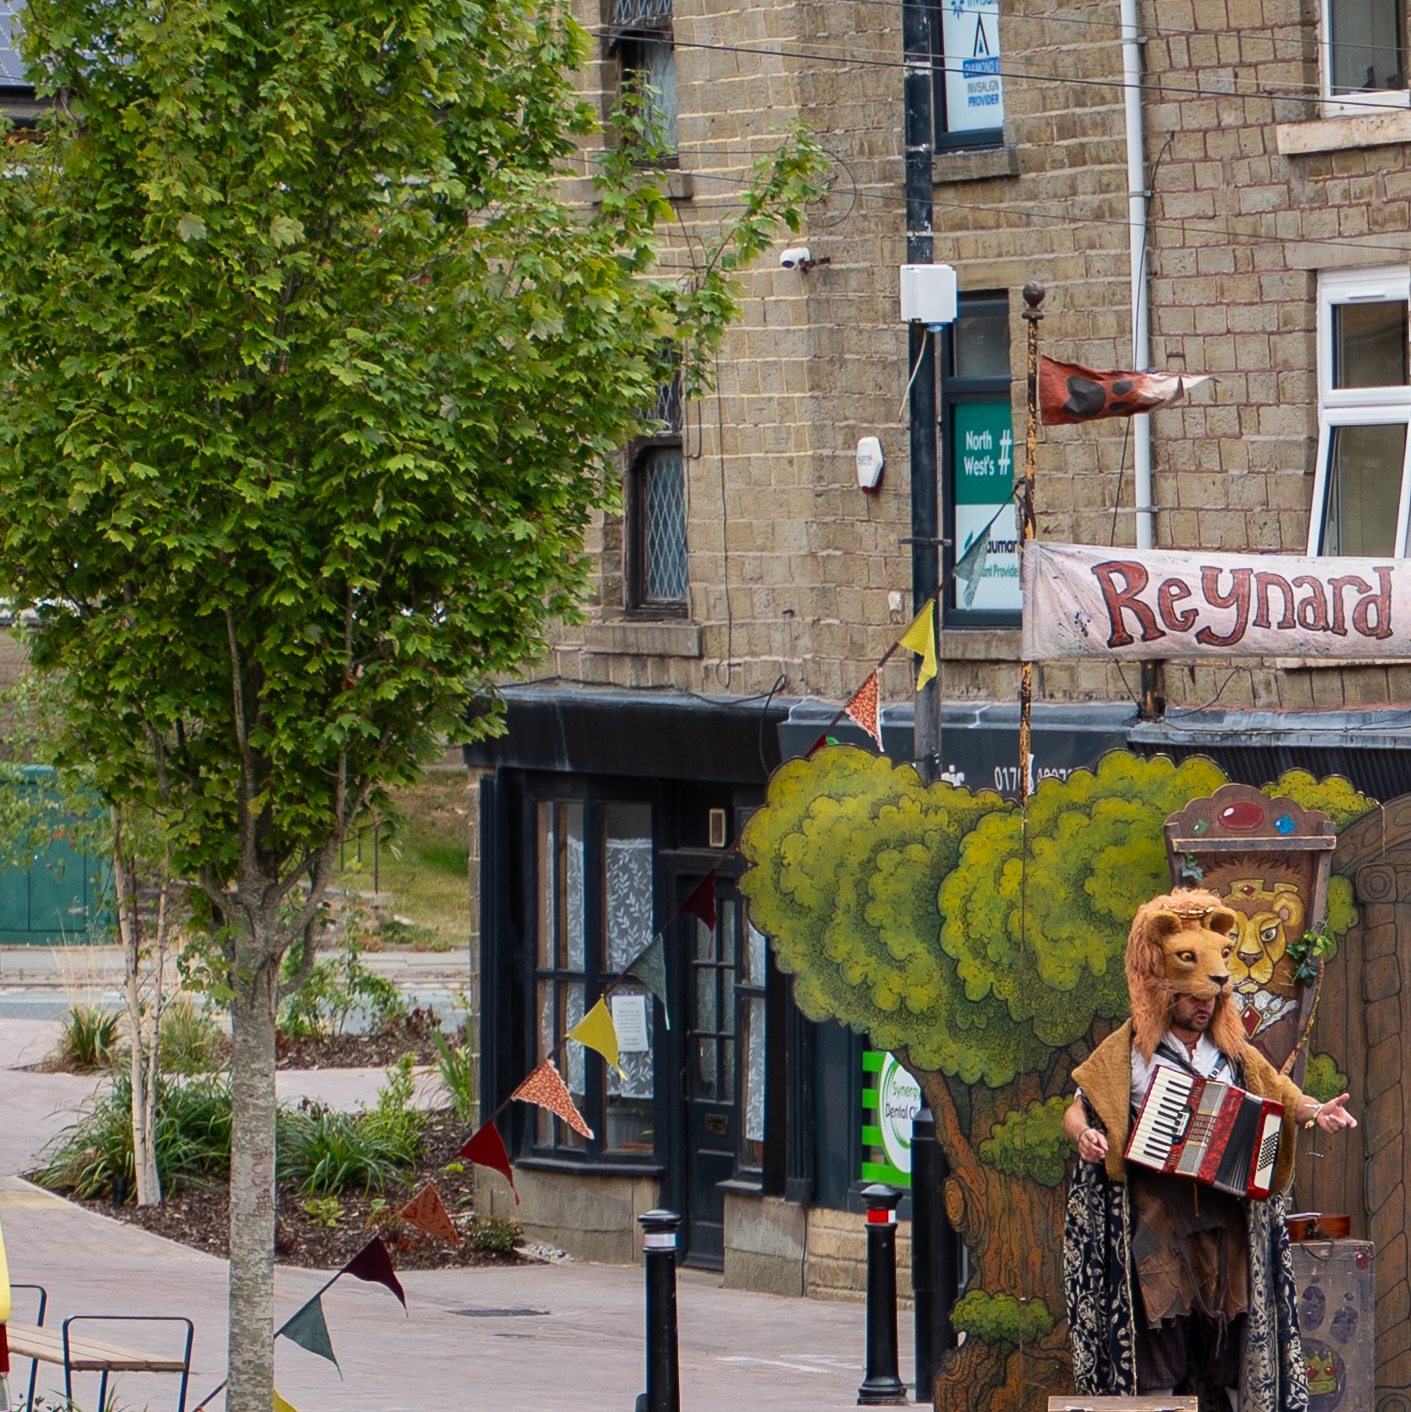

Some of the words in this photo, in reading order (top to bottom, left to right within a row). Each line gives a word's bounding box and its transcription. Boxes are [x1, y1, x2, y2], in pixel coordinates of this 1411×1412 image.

[968, 94, 1000, 107] PROVIDER
[965, 430, 993, 451] North
[963, 454, 995, 476] West's
[993, 562, 1018, 577] Provide
[1091, 560, 1395, 648] Reynard
[892, 1081, 921, 1099] Synerg
[885, 1103, 908, 1119] Dental
